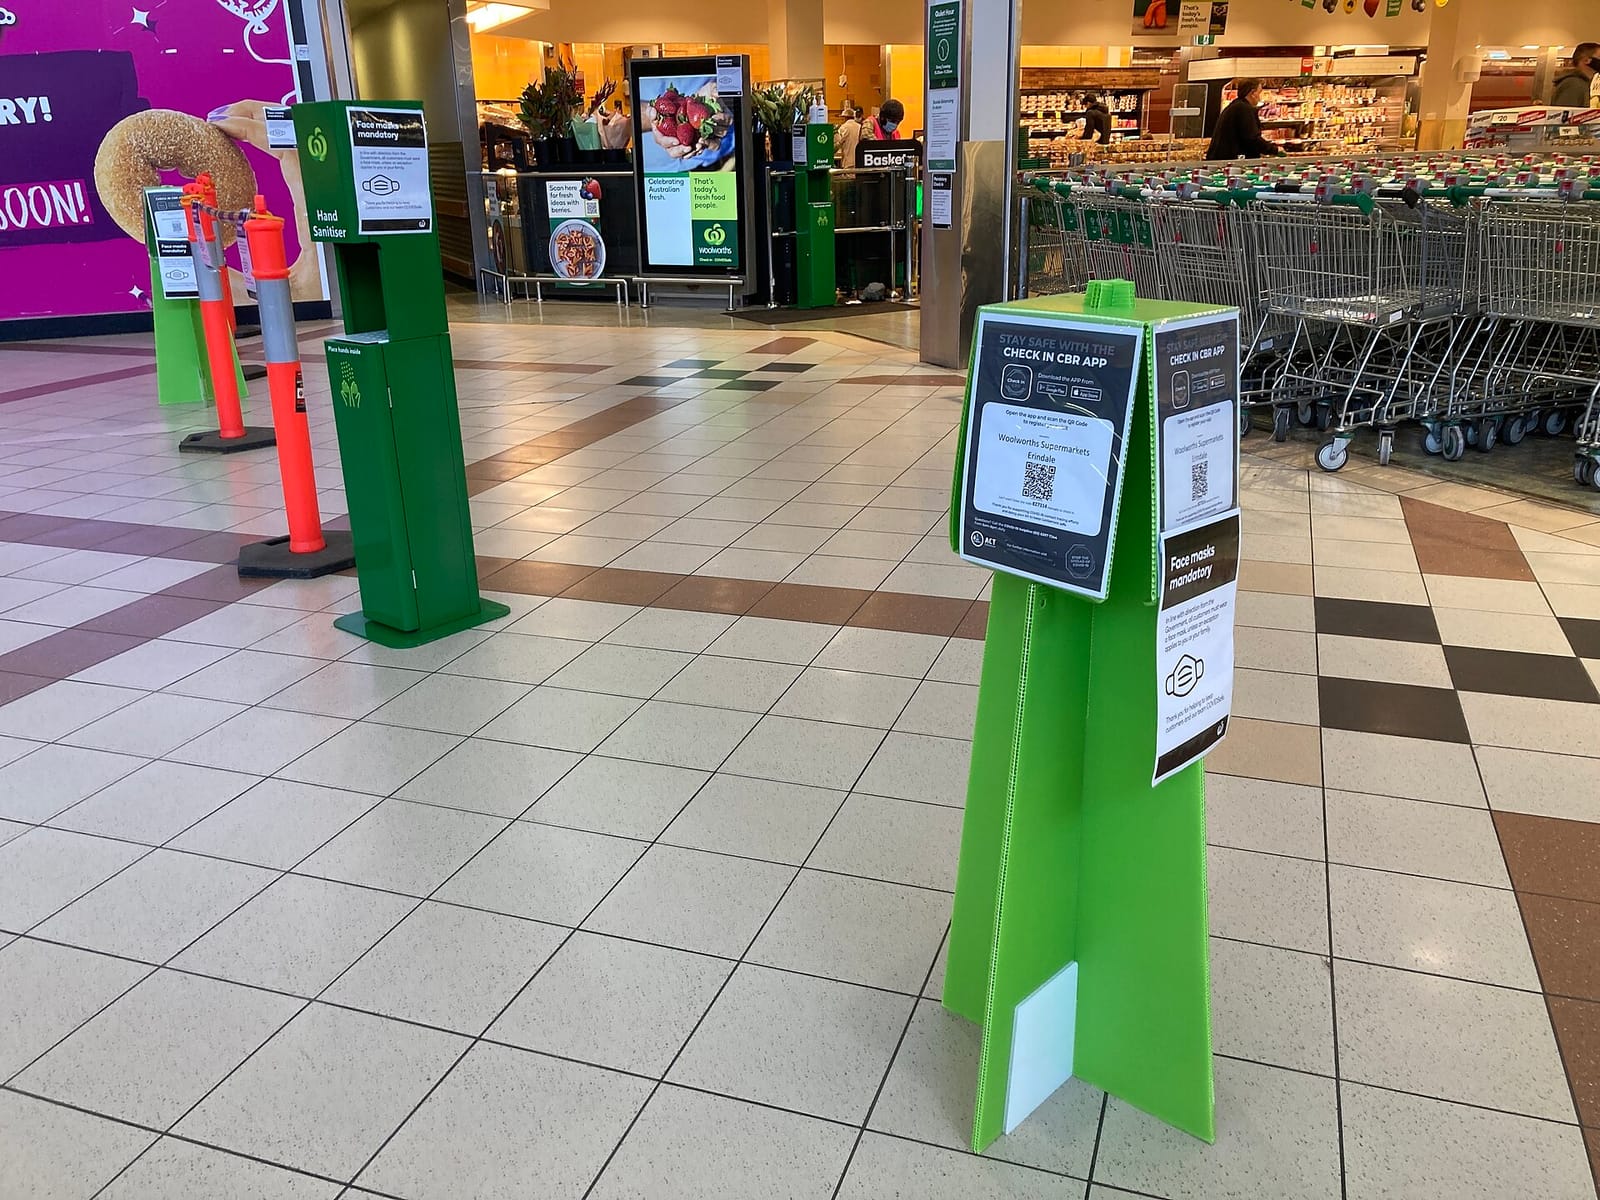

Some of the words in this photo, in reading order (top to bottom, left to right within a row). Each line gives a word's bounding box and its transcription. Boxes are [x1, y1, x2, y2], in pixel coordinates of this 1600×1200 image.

[356, 120, 374, 128] Face
[358, 130, 399, 141] mandatory
[864, 153, 914, 166] Basket
[317, 209, 338, 221] Hand
[313, 225, 346, 238] Sanitiser
[1000, 334, 1026, 346] STAY
[1028, 337, 1056, 349] SAFE
[1060, 340, 1089, 353] WITH
[1092, 344, 1115, 356] THE
[1003, 347, 1040, 360] CHECK
[1042, 352, 1054, 362] IN
[1057, 354, 1080, 365] CBR
[1082, 356, 1107, 368] APP
[1170, 352, 1191, 366] CHECK
[1192, 350, 1199, 360] IN
[1200, 347, 1212, 359] CBR
[1213, 345, 1225, 356] APP
[998, 433, 1039, 448] Woolworths
[1041, 441, 1090, 456] Supermarkets
[1028, 452, 1055, 463] Erindale
[985, 537, 996, 546] ACT
[1171, 556, 1190, 571] Face
[1191, 544, 1215, 564] masks
[1170, 564, 1212, 590] mandatory
